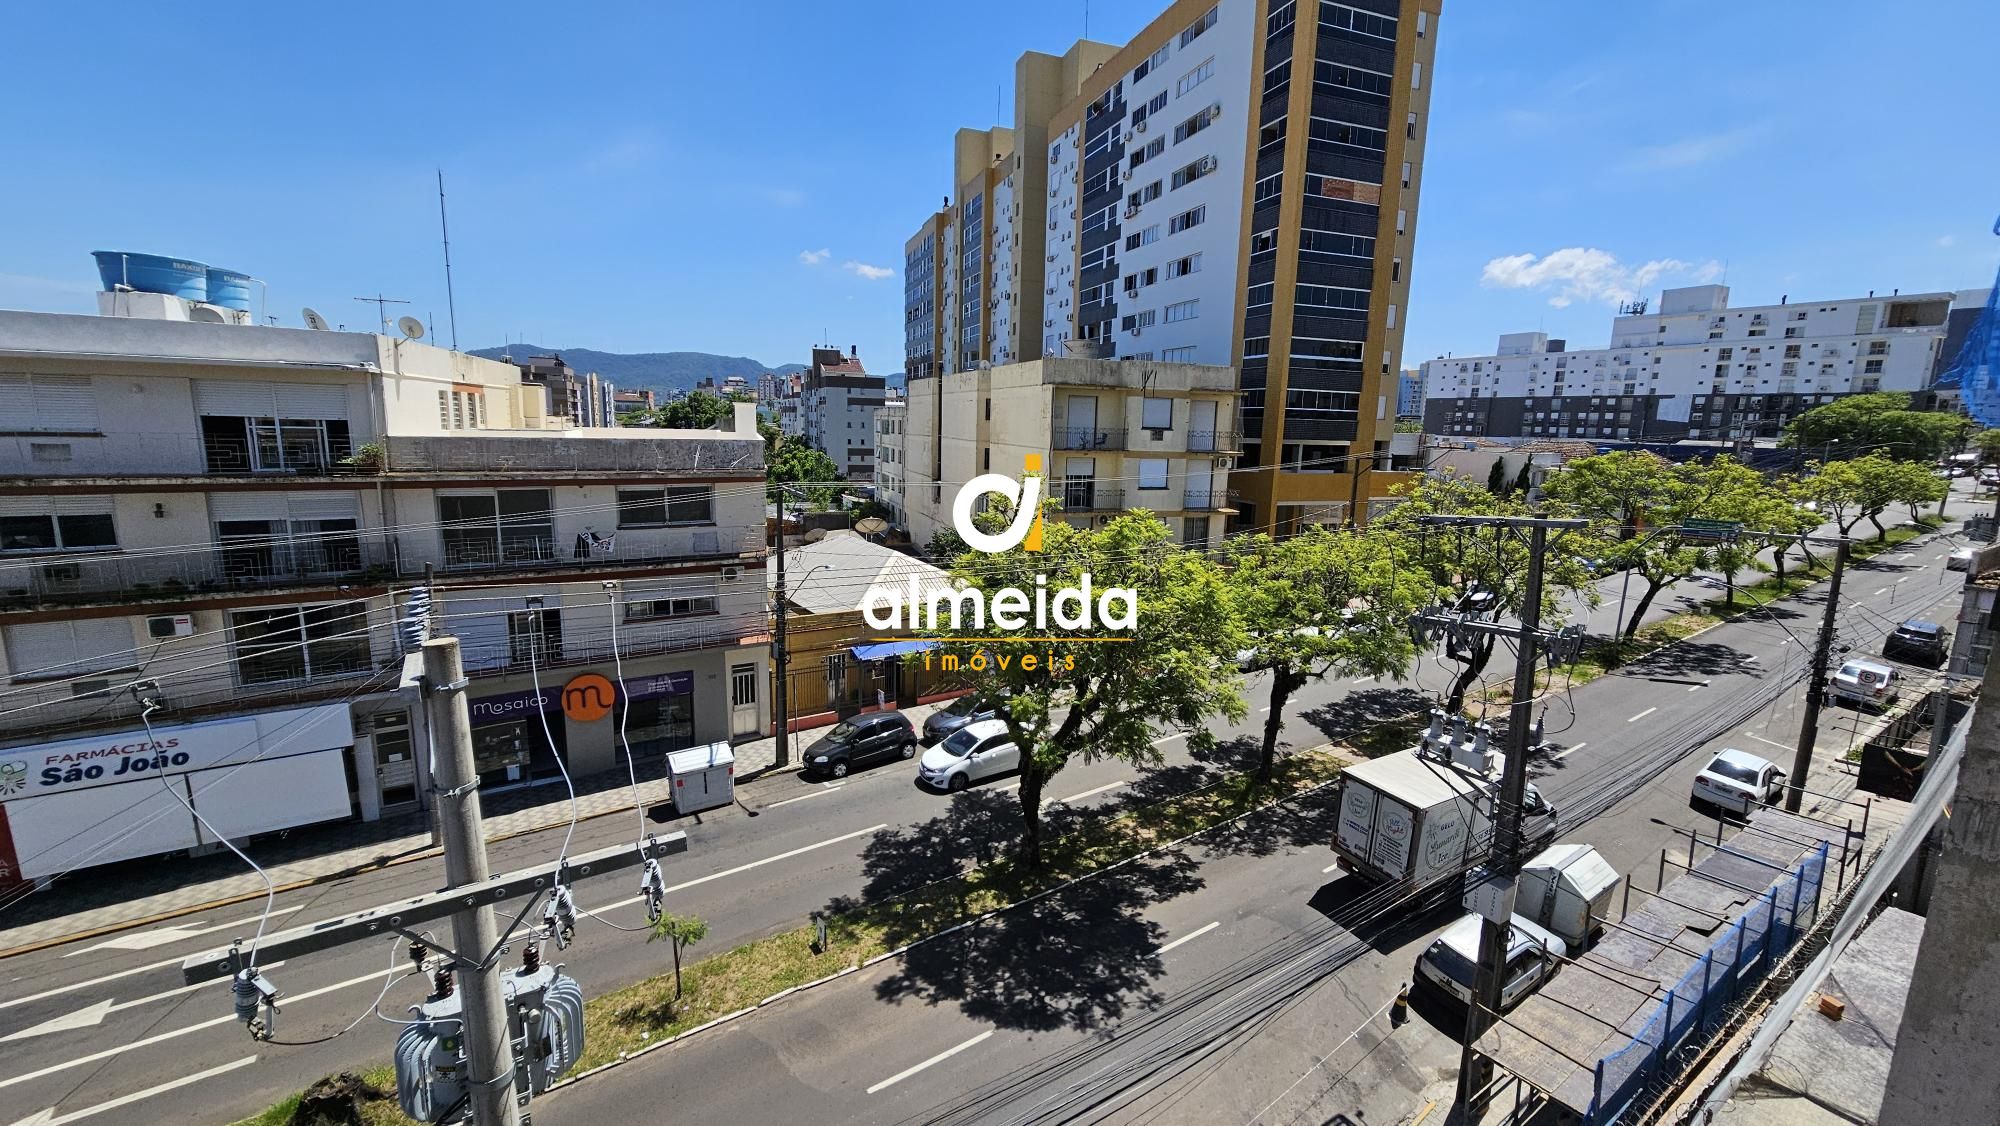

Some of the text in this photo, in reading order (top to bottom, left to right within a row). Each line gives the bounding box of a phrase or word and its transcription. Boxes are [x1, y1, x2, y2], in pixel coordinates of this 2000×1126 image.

[45, 738, 180, 765] FARMÁCIAS
[40, 750, 190, 787] São João
